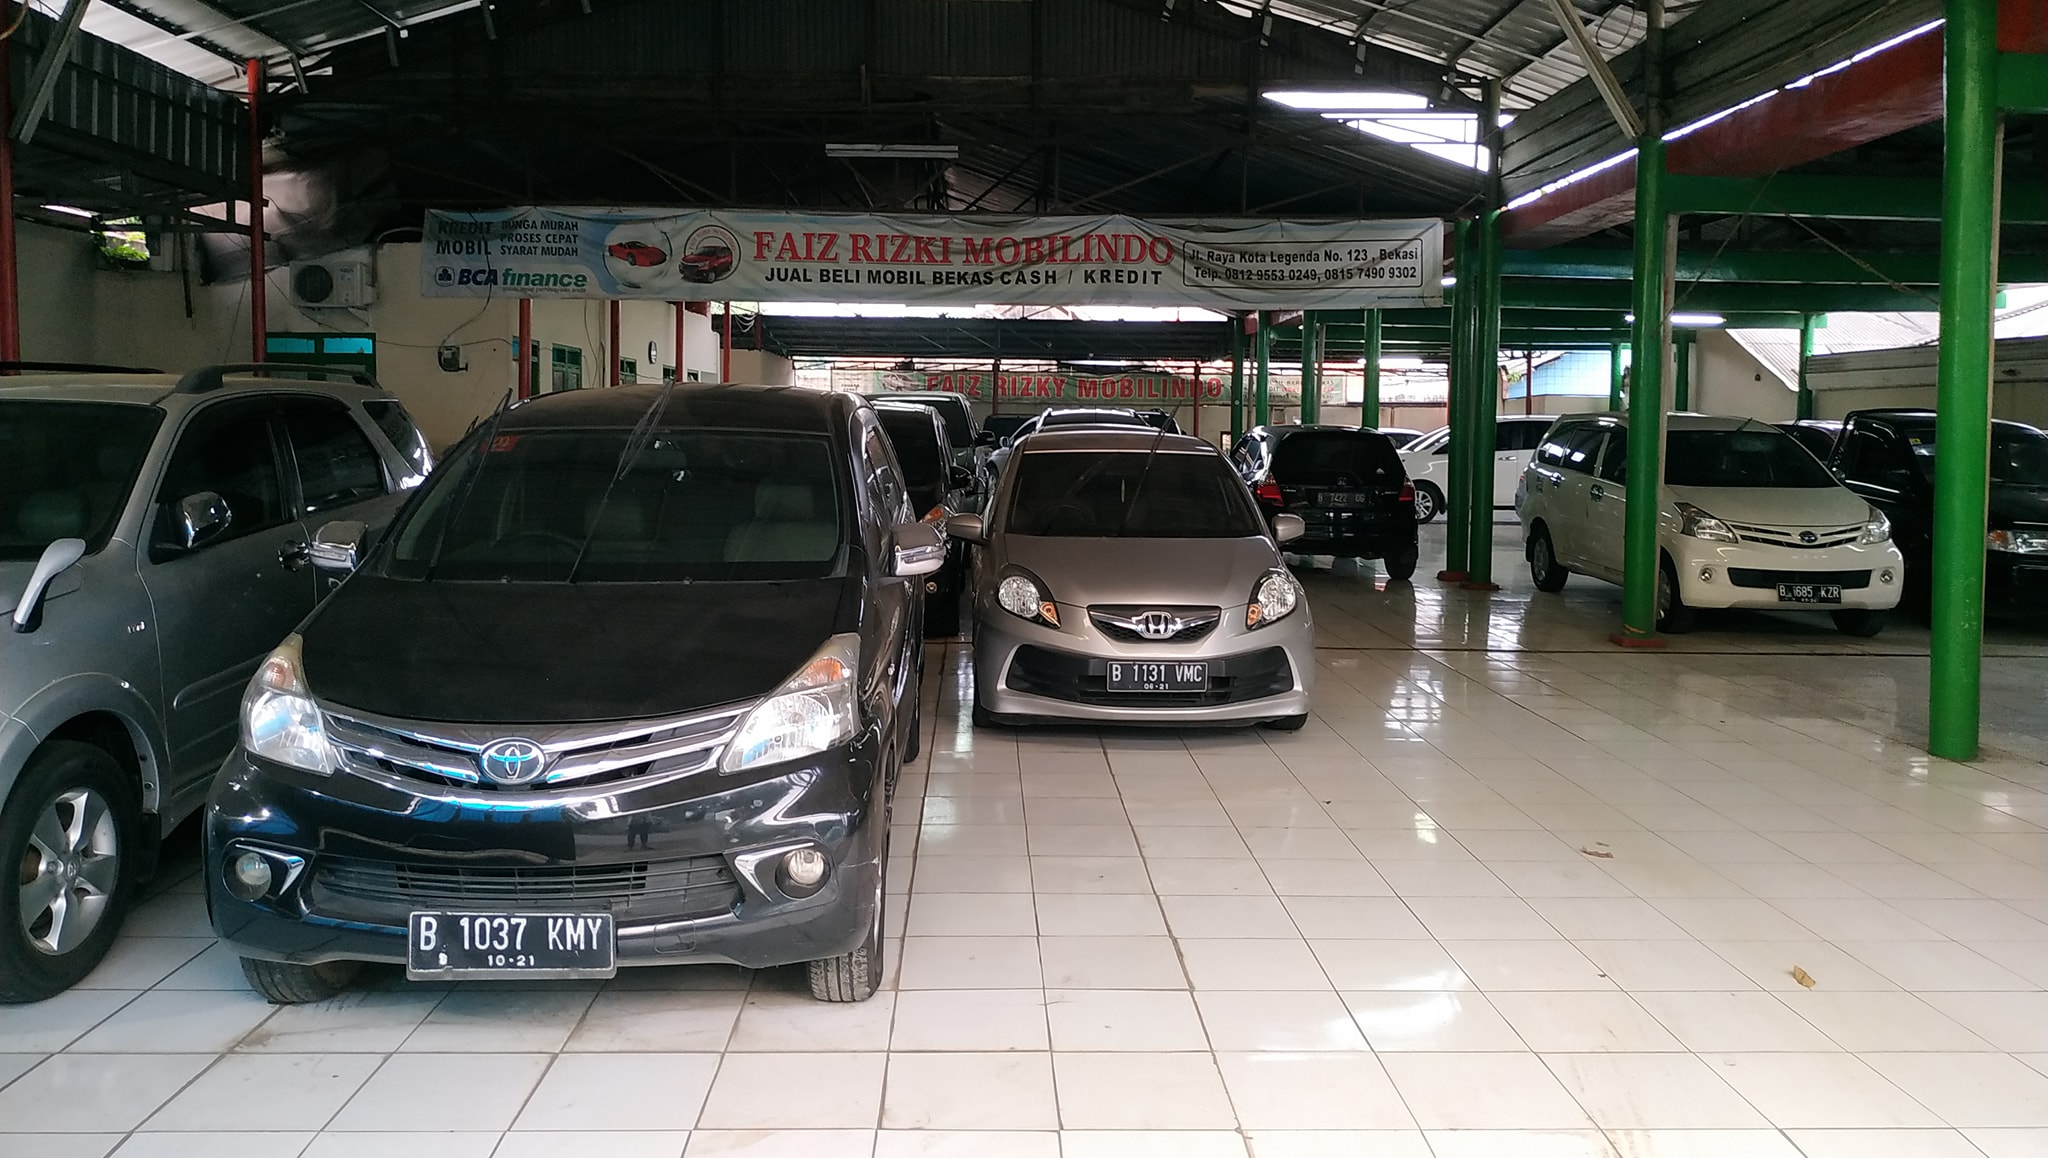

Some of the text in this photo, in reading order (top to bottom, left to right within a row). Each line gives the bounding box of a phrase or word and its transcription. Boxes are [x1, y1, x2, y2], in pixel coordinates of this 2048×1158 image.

[438, 221, 494, 234] KREDIT
[502, 220, 578, 231] BUNGA MURAH
[500, 233, 578, 244] PROSES CEPAT
[436, 240, 492, 255] MOBIL
[500, 245, 578, 257] SYARAT MUDAH
[753, 231, 841, 262] FAIZ
[849, 234, 952, 264] RIZKI
[962, 234, 1174, 266] MOBILINDO
[1189, 249, 1203, 262] Jl.
[1208, 252, 1235, 265] Raya
[1240, 251, 1266, 264] Kota
[1270, 250, 1320, 266] Legenda
[1324, 250, 1344, 262] No.
[1347, 249, 1368, 262] 123
[1379, 248, 1418, 261] Bekasi
[458, 268, 587, 288] BCA finance
[764, 267, 1162, 286] JUAL BELI MOBIL BEKAS CASH / KREDIT
[1194, 266, 1416, 283] Telp. 0812 9553 0249, 0815 7490 9302
[926, 375, 1222, 399] FAIZ RIZKY MOBILINDO
[1780, 586, 1786, 596] B
[1820, 587, 1839, 598] KZR
[1112, 664, 1202, 682] B 1131 VMC
[420, 916, 602, 951] B 1037 KMY
